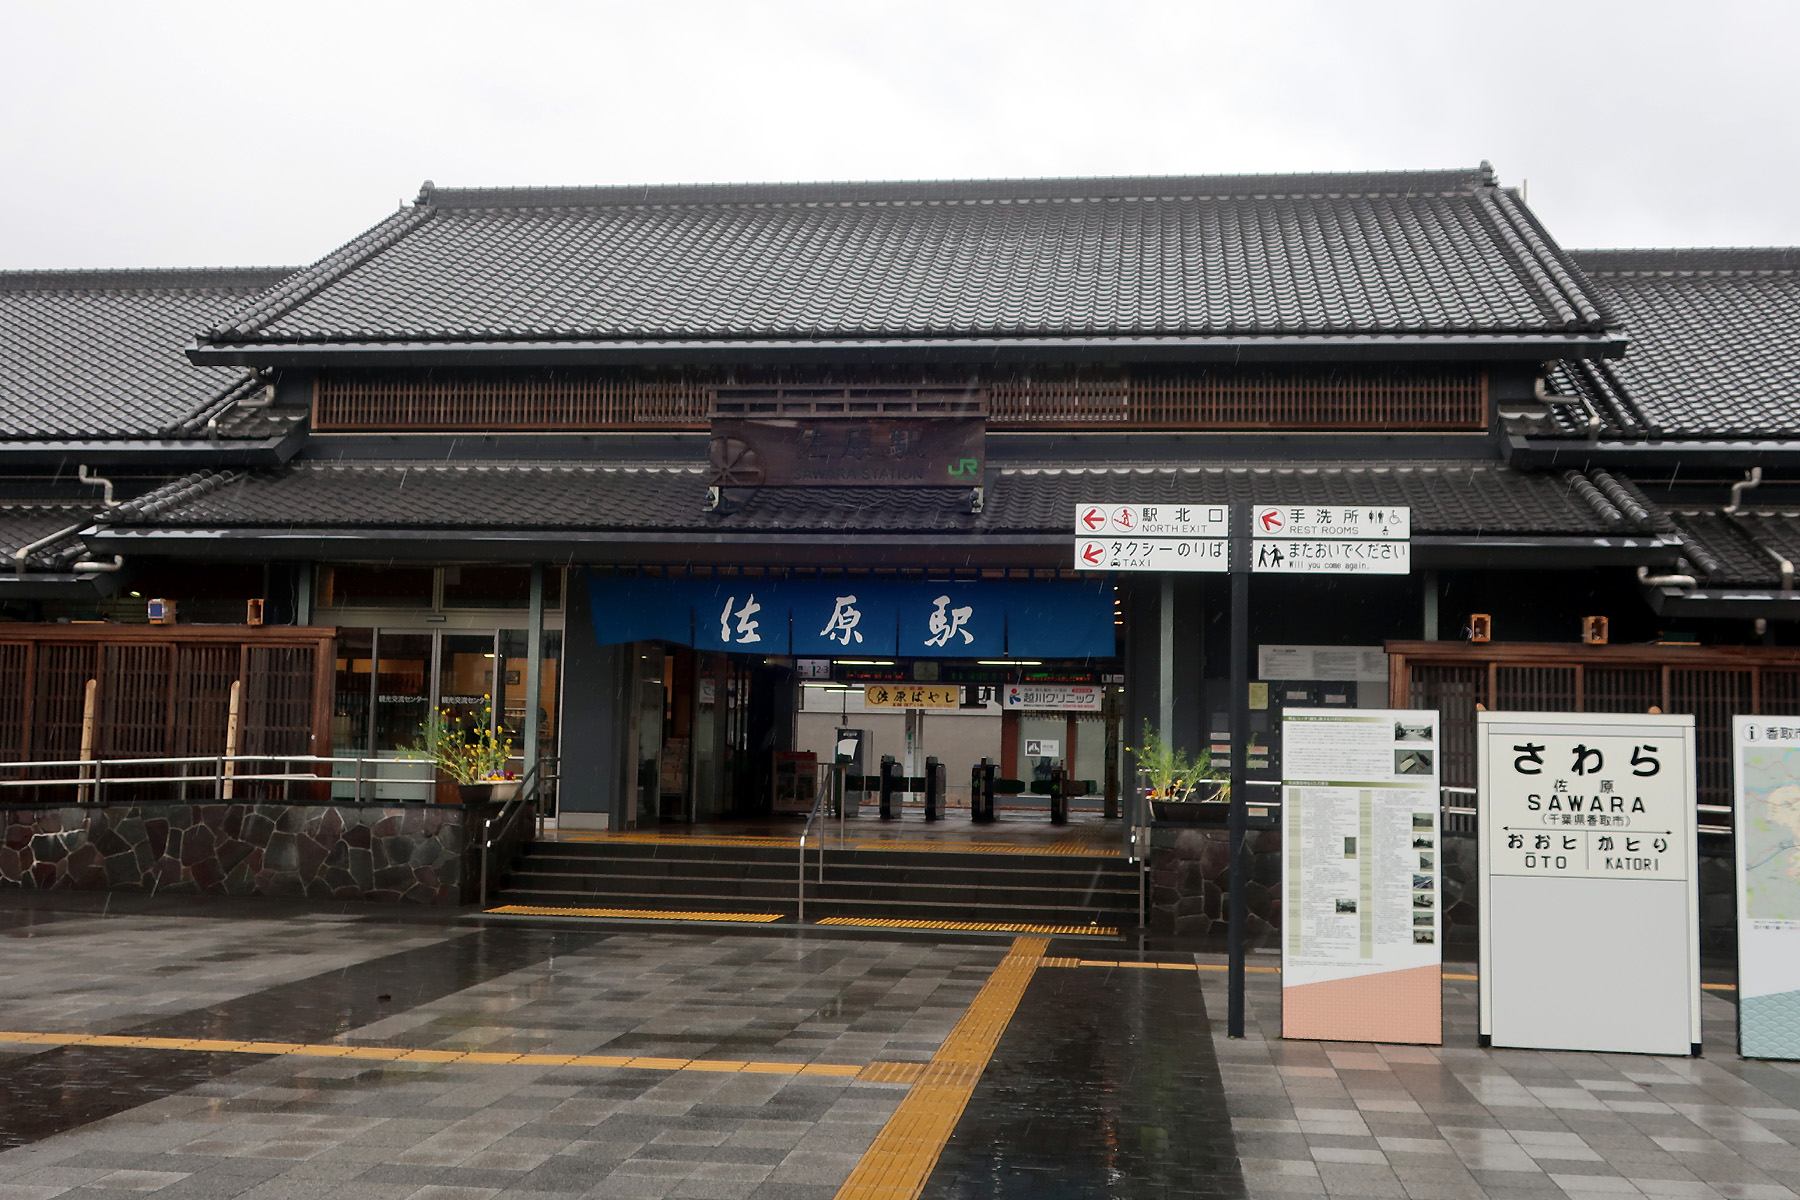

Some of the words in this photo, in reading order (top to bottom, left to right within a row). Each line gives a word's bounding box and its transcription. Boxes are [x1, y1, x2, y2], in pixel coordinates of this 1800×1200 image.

[796, 426, 926, 461] 佐原駅
[794, 468, 857, 481] SAWARA
[862, 467, 924, 481] STATION
[947, 458, 978, 475] JR
[1142, 507, 1223, 523] 駅北口
[1290, 508, 1359, 524] 手洗所
[1142, 524, 1179, 533] NORTH
[1182, 524, 1208, 533] EXIT
[1289, 526, 1317, 534] REST
[1321, 526, 1359, 535] ROOMS
[1111, 541, 1224, 558] タクシーのりば
[1289, 543, 1406, 559] またおいでください
[1122, 559, 1151, 567] TAXI
[1289, 561, 1304, 569] Will
[1345, 562, 1370, 571] again.
[720, 593, 974, 647] 佐原駅
[876, 690, 956, 702] 佐原ばやし
[1513, 742, 1660, 777] さわら
[1554, 779, 1615, 794] 佐原
[1527, 794, 1645, 813] SAWARA
[1507, 833, 1577, 851] おおと
[1598, 836, 1668, 853] かとり
[1606, 857, 1659, 872] KATORI
